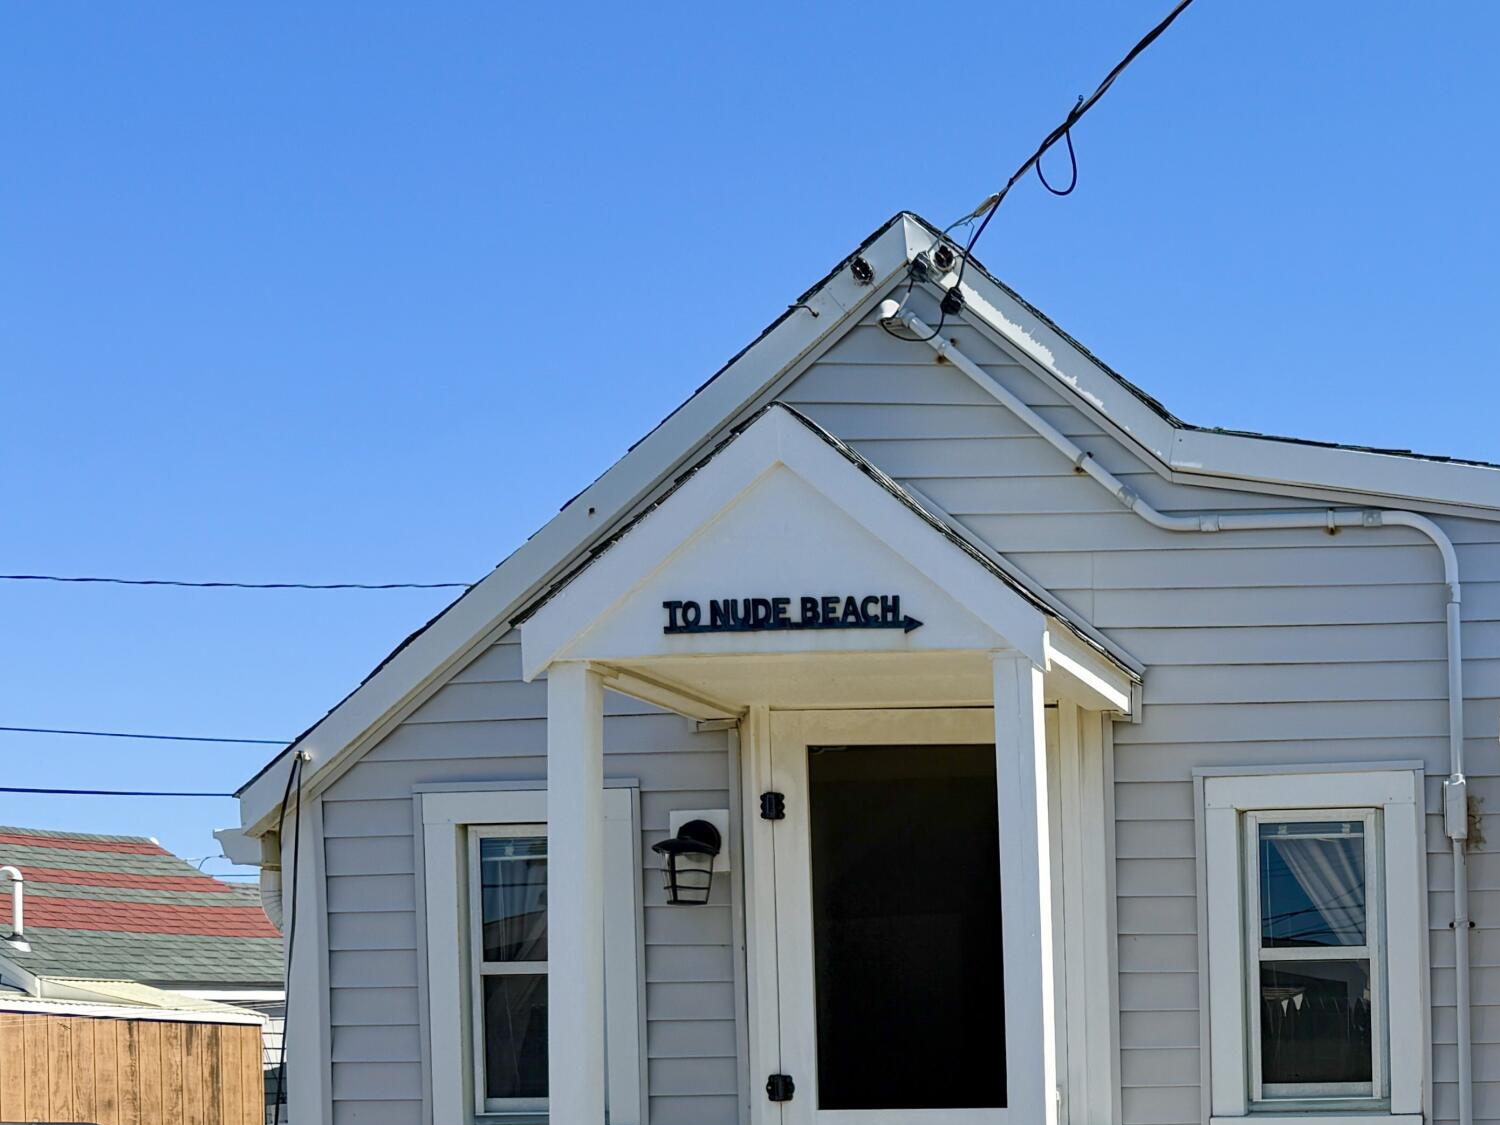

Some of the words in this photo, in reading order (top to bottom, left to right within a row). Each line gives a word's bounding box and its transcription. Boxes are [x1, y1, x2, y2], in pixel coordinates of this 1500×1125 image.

[663, 600, 701, 628] TO
[710, 597, 791, 628] NUDE
[801, 595, 900, 627] BEACH
